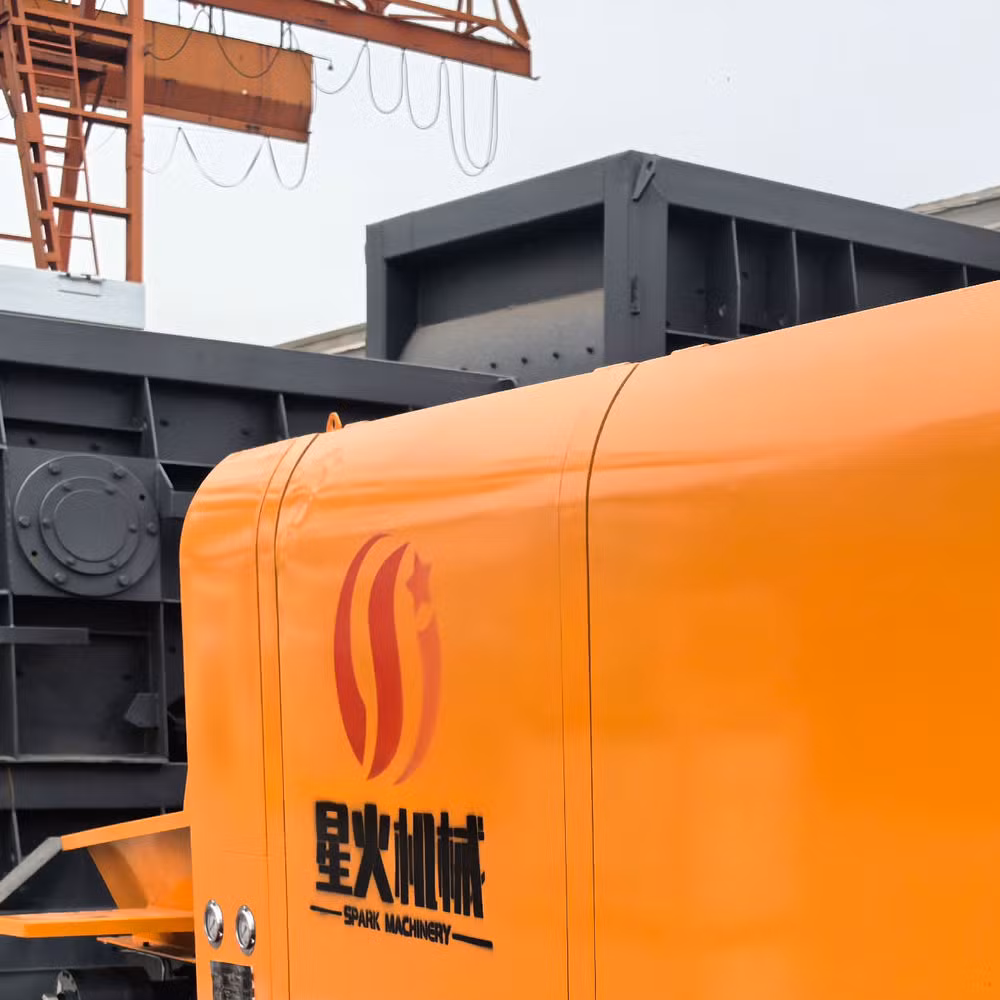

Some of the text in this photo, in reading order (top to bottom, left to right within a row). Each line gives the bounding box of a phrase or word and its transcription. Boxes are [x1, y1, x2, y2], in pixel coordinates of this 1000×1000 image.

[315, 801, 485, 919] 星火机械
[343, 905, 452, 946] SPARK MACHINERY
